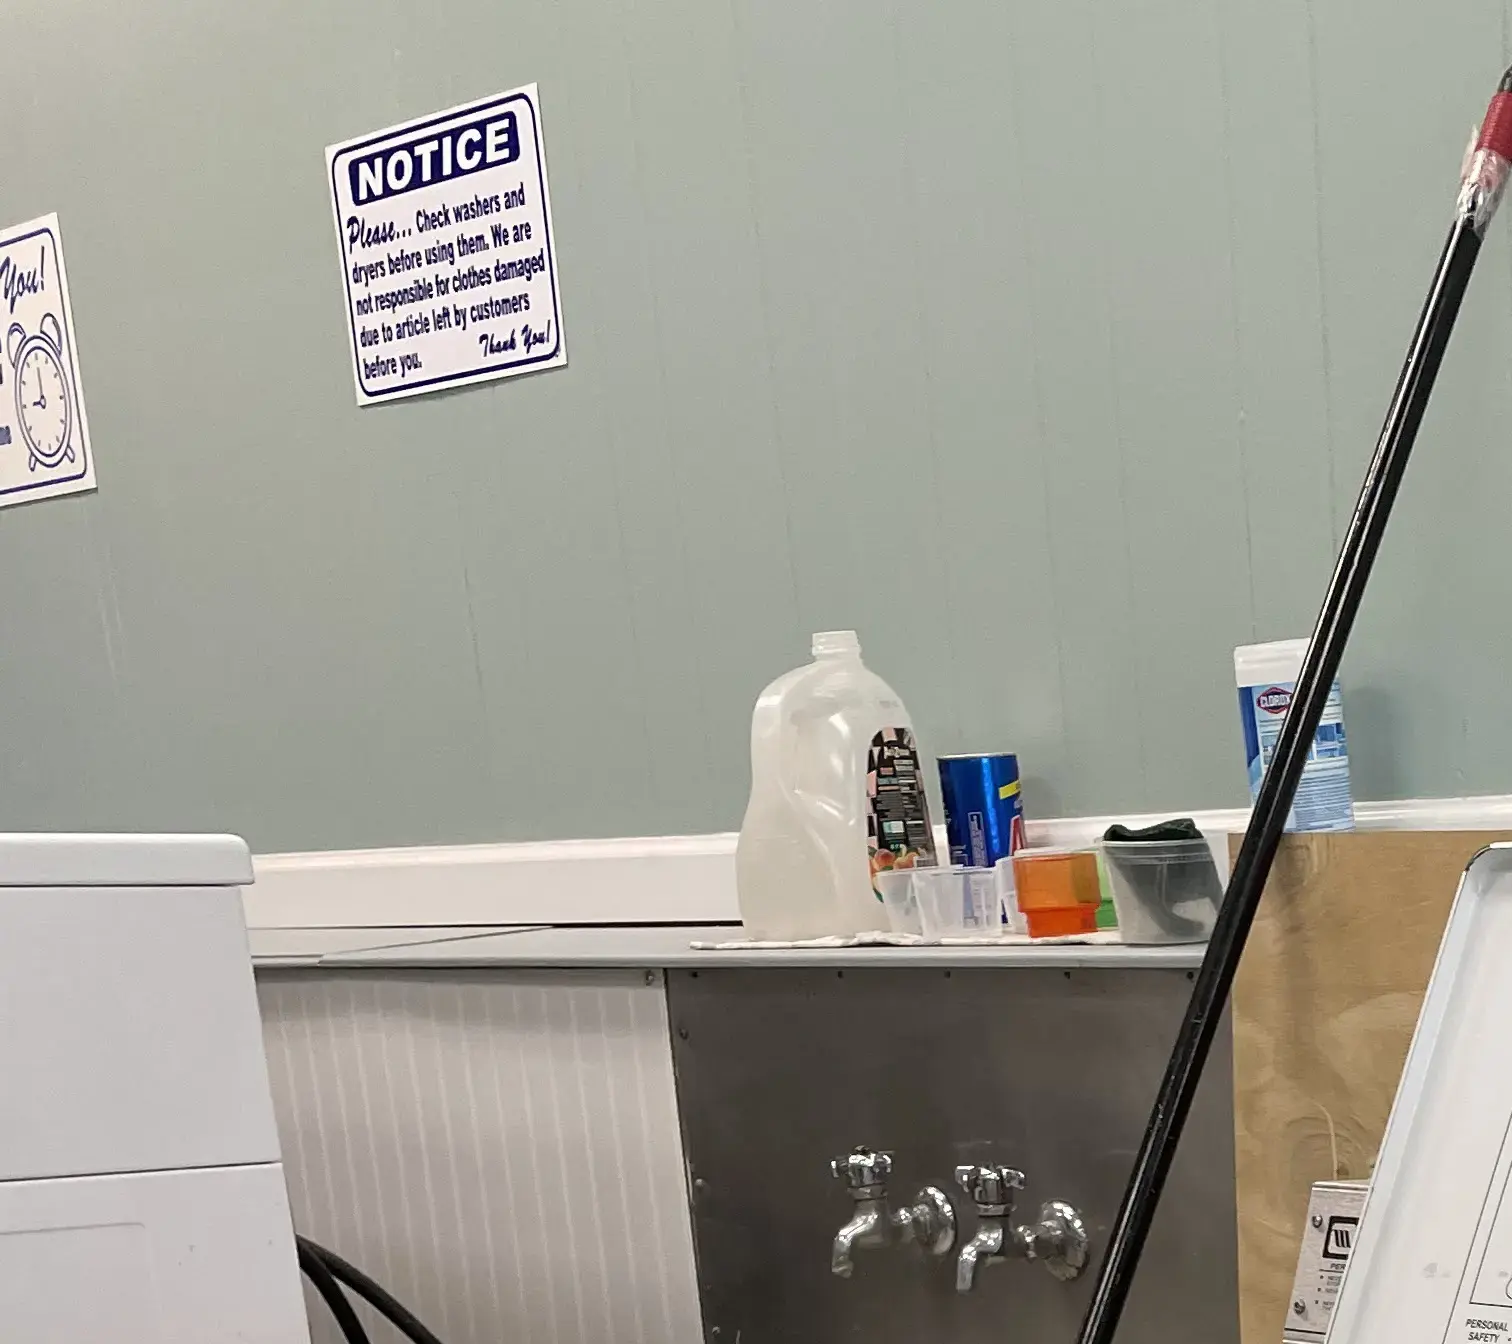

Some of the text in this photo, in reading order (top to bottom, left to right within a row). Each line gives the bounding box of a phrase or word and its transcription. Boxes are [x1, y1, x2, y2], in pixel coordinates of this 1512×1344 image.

[358, 118, 510, 201] NOTICE
[347, 182, 525, 254] Please... Check washers and
[0, 245, 45, 314] You!
[353, 221, 532, 287] dryers before using them. We are
[356, 248, 546, 316] not responsible for clothes damaged
[360, 292, 530, 348] due to article left by customers
[478, 319, 551, 357] Thank You!
[362, 352, 423, 380] before you.
[1465, 1318, 1509, 1332] PERSONAL
[1467, 1332, 1500, 1344] SAFETY
